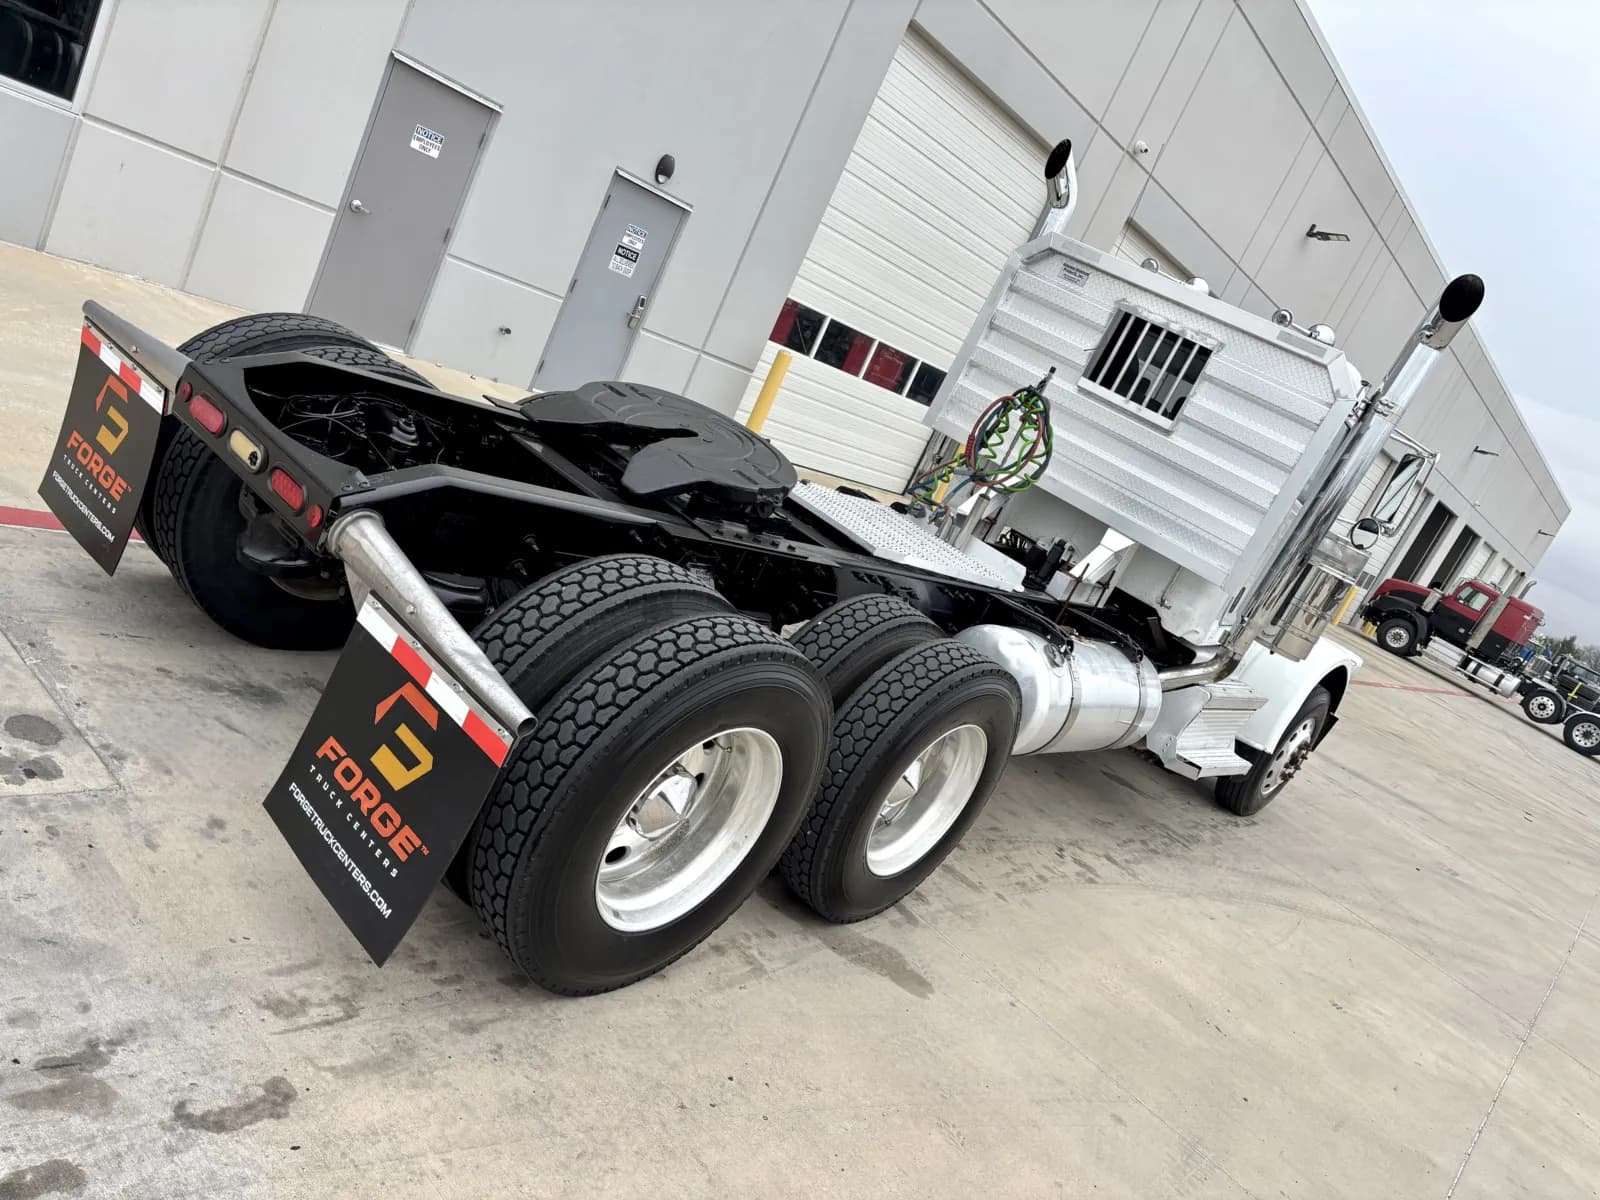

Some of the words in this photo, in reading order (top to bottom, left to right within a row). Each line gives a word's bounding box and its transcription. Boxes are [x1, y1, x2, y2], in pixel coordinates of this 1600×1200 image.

[413, 134, 440, 151] EMPLOYEES
[416, 126, 444, 144] NOTICE
[617, 247, 638, 261] NOTICE
[52, 470, 116, 544] FORGETRUCKCENTERS.COM
[63, 454, 83, 480] TRUCK
[84, 479, 117, 515] CENTERS
[288, 781, 393, 919] FORGETRUCKCENTERS.COM
[308, 764, 343, 809] TRUCK
[346, 812, 399, 878] CENTERS
